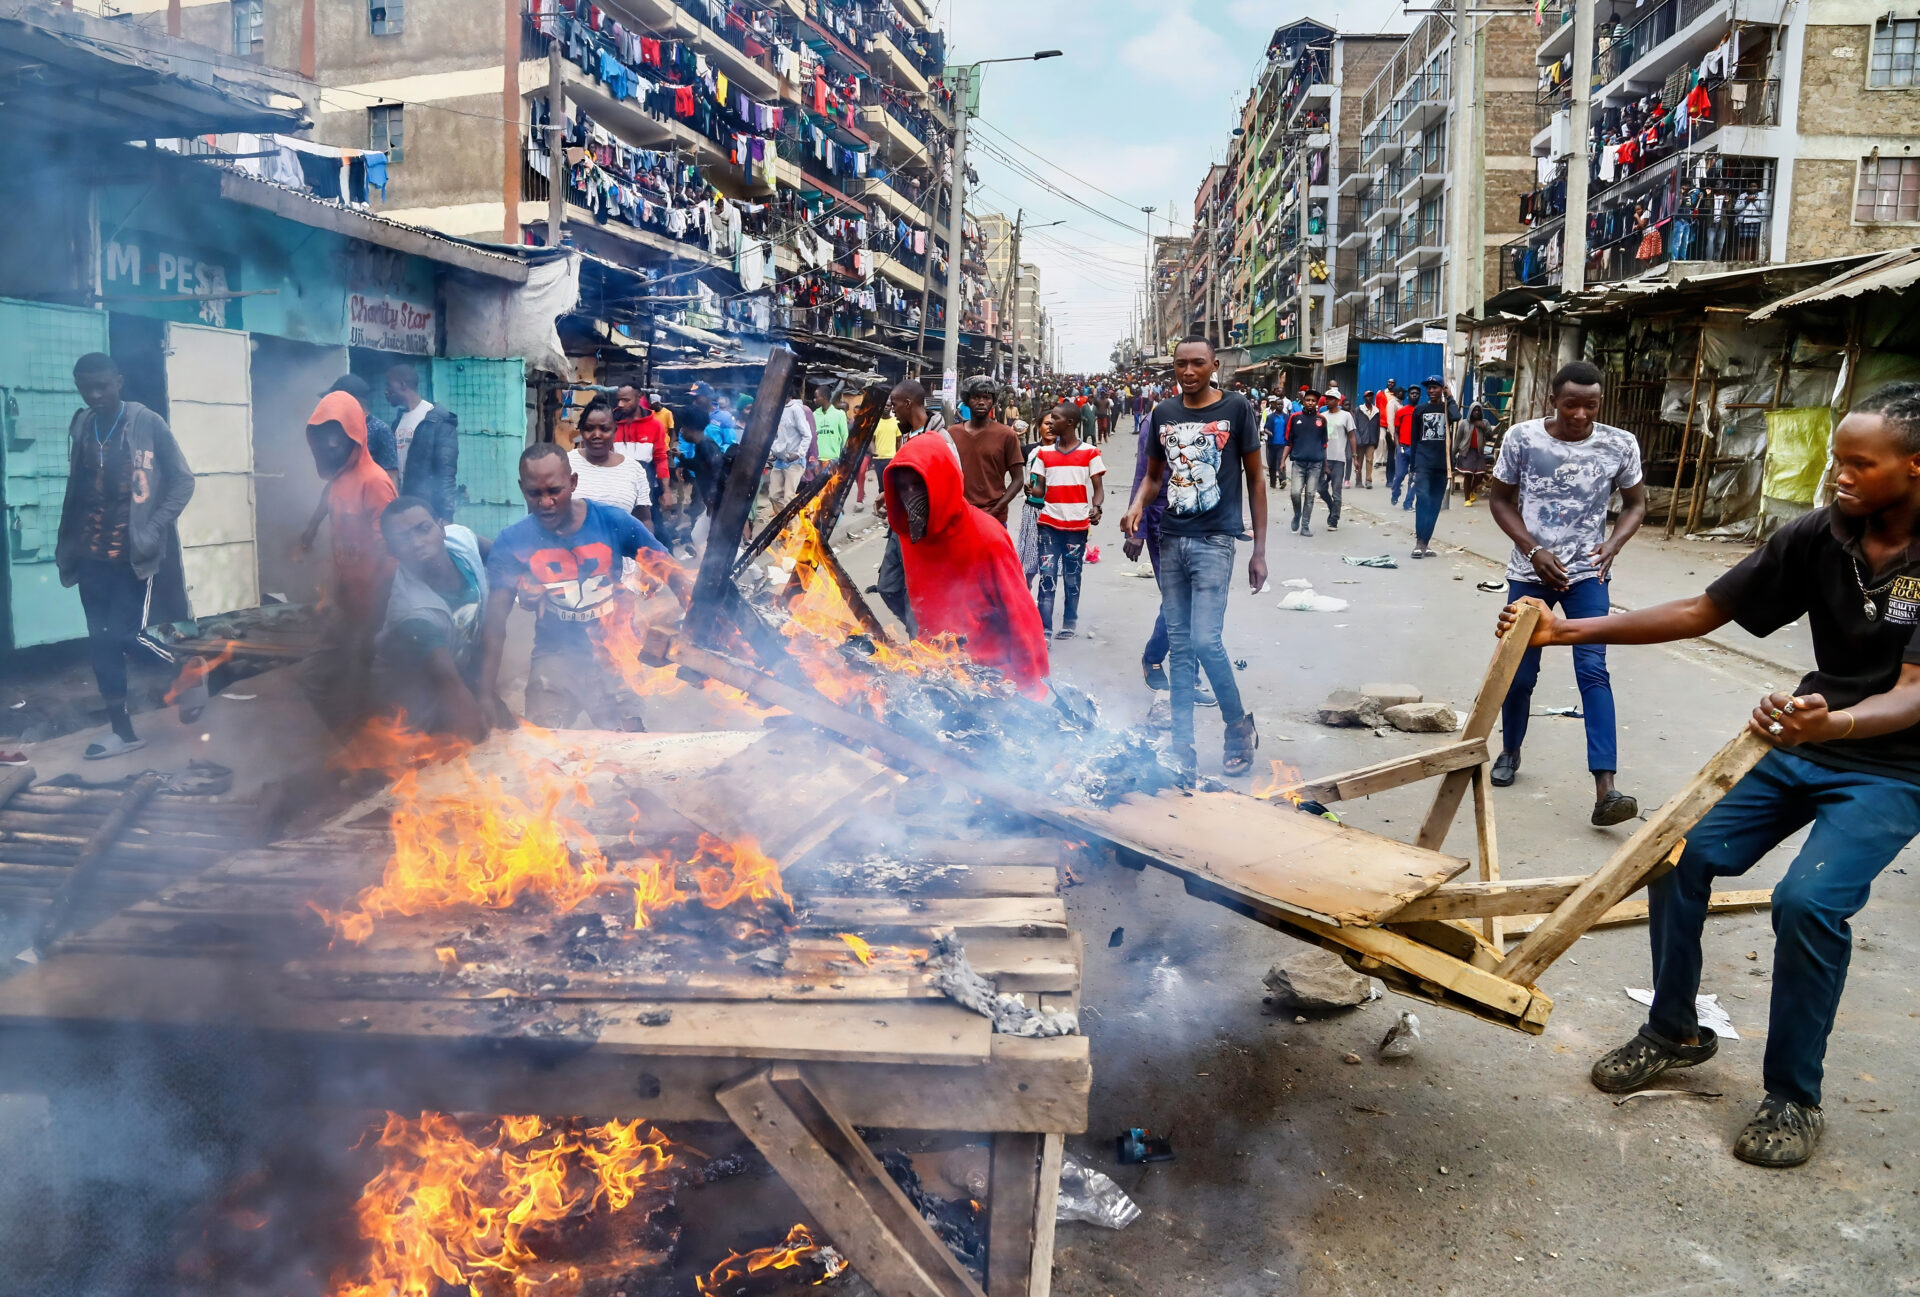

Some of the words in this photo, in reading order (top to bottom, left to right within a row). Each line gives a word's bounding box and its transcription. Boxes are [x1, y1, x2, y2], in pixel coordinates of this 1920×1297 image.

[351, 294, 399, 330] Charity
[400, 301, 432, 330] Star
[529, 541, 614, 609] 92
[1888, 601, 1918, 611] QUALITY
[1888, 607, 1916, 618] WHISKY
